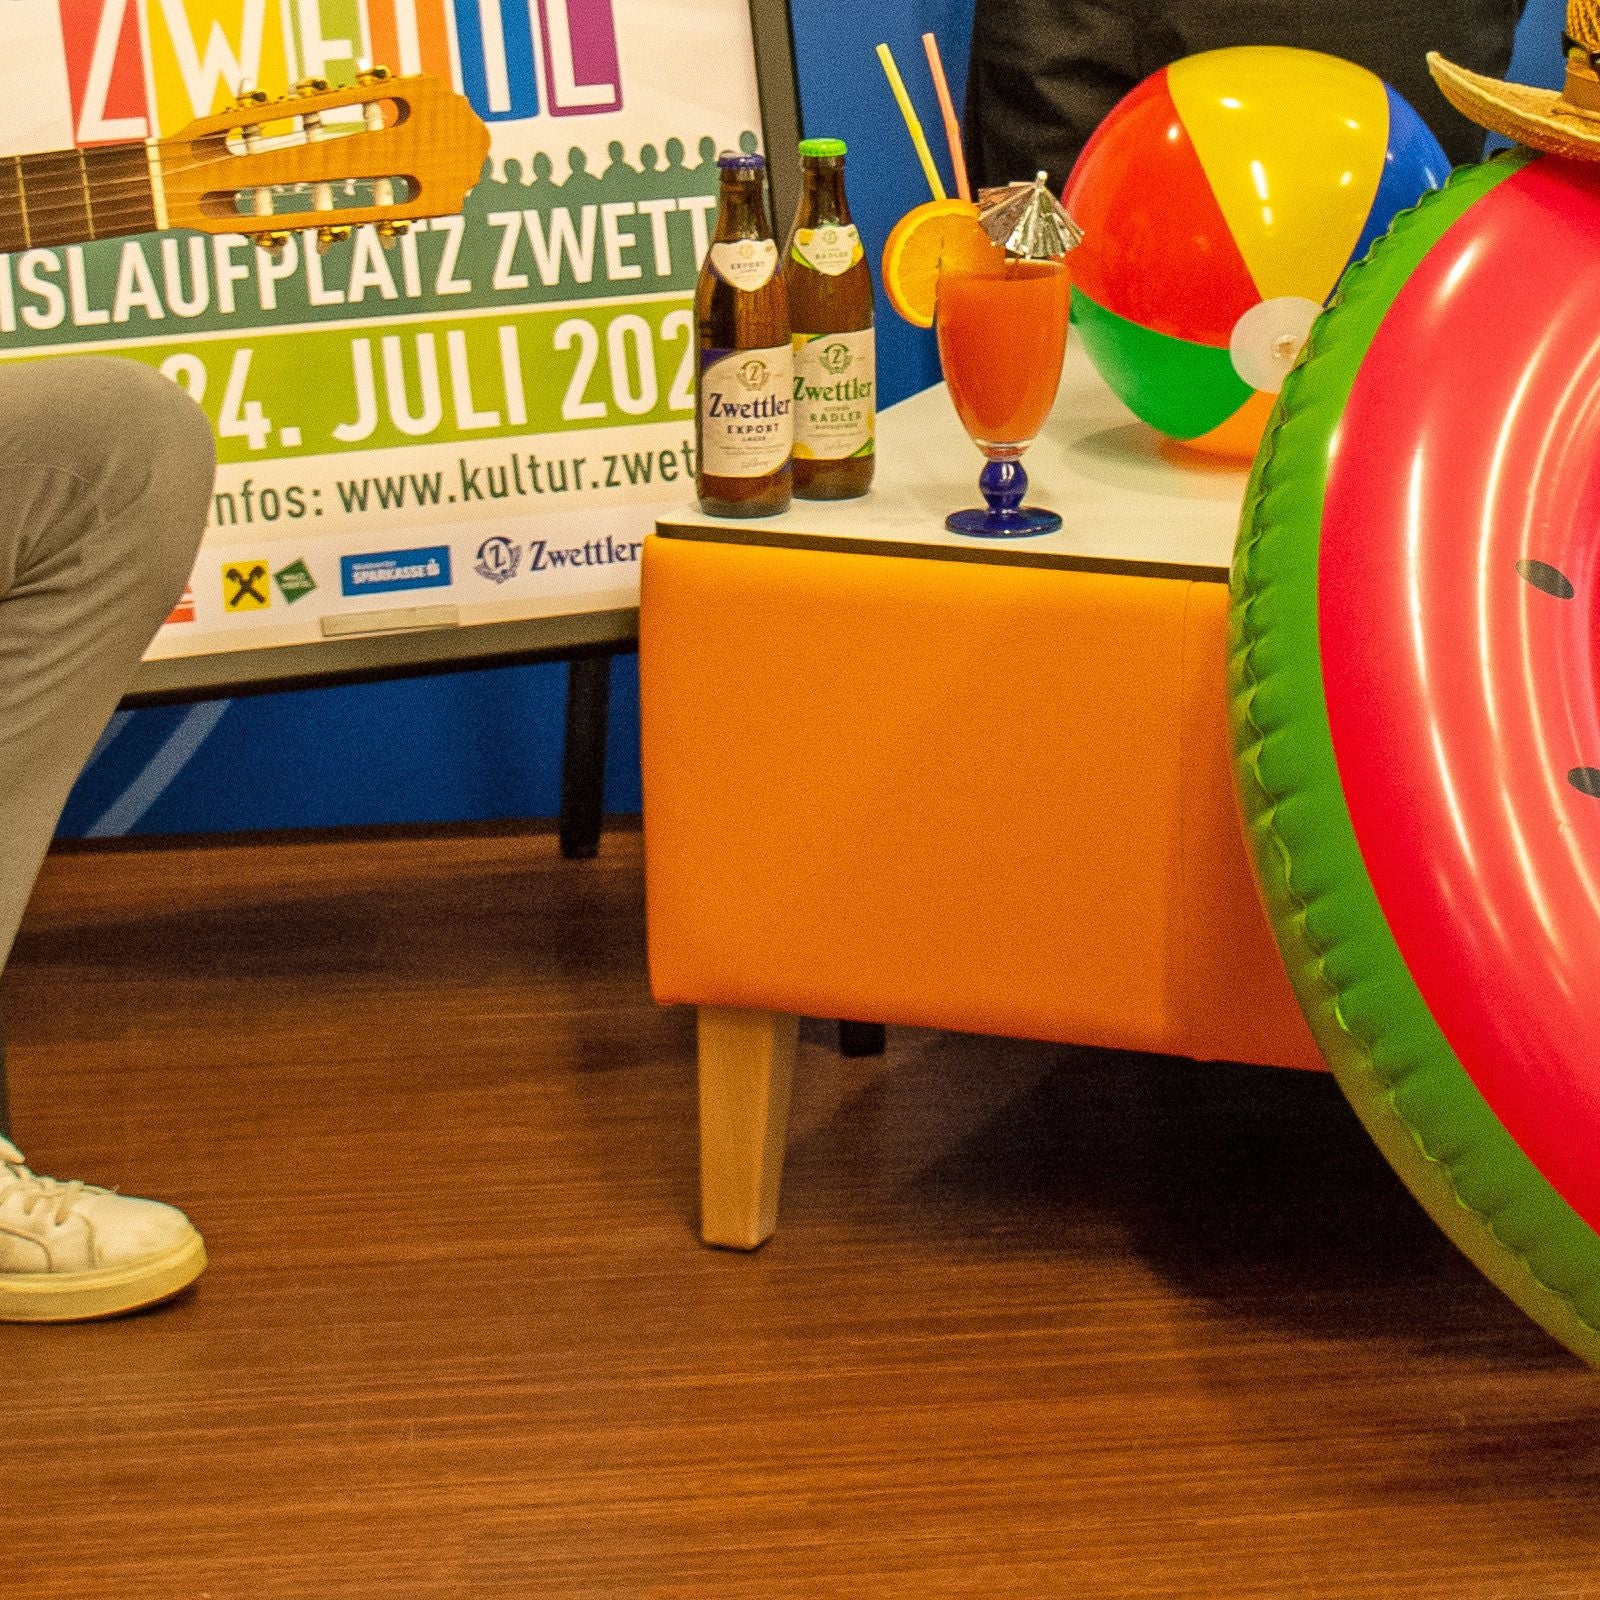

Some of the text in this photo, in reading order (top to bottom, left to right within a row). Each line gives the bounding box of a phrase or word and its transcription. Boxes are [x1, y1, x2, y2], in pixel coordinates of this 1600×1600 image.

[488, 194, 718, 292] ZWETT
[332, 325, 528, 443] JULI
[553, 308, 696, 422] 202
[792, 376, 872, 401] Zwettler
[709, 393, 791, 420] Zwettler
[810, 411, 862, 423] RADLER
[727, 422, 779, 434] EXPORT
[214, 479, 324, 526] nfos:
[529, 534, 643, 572] Zwettler
